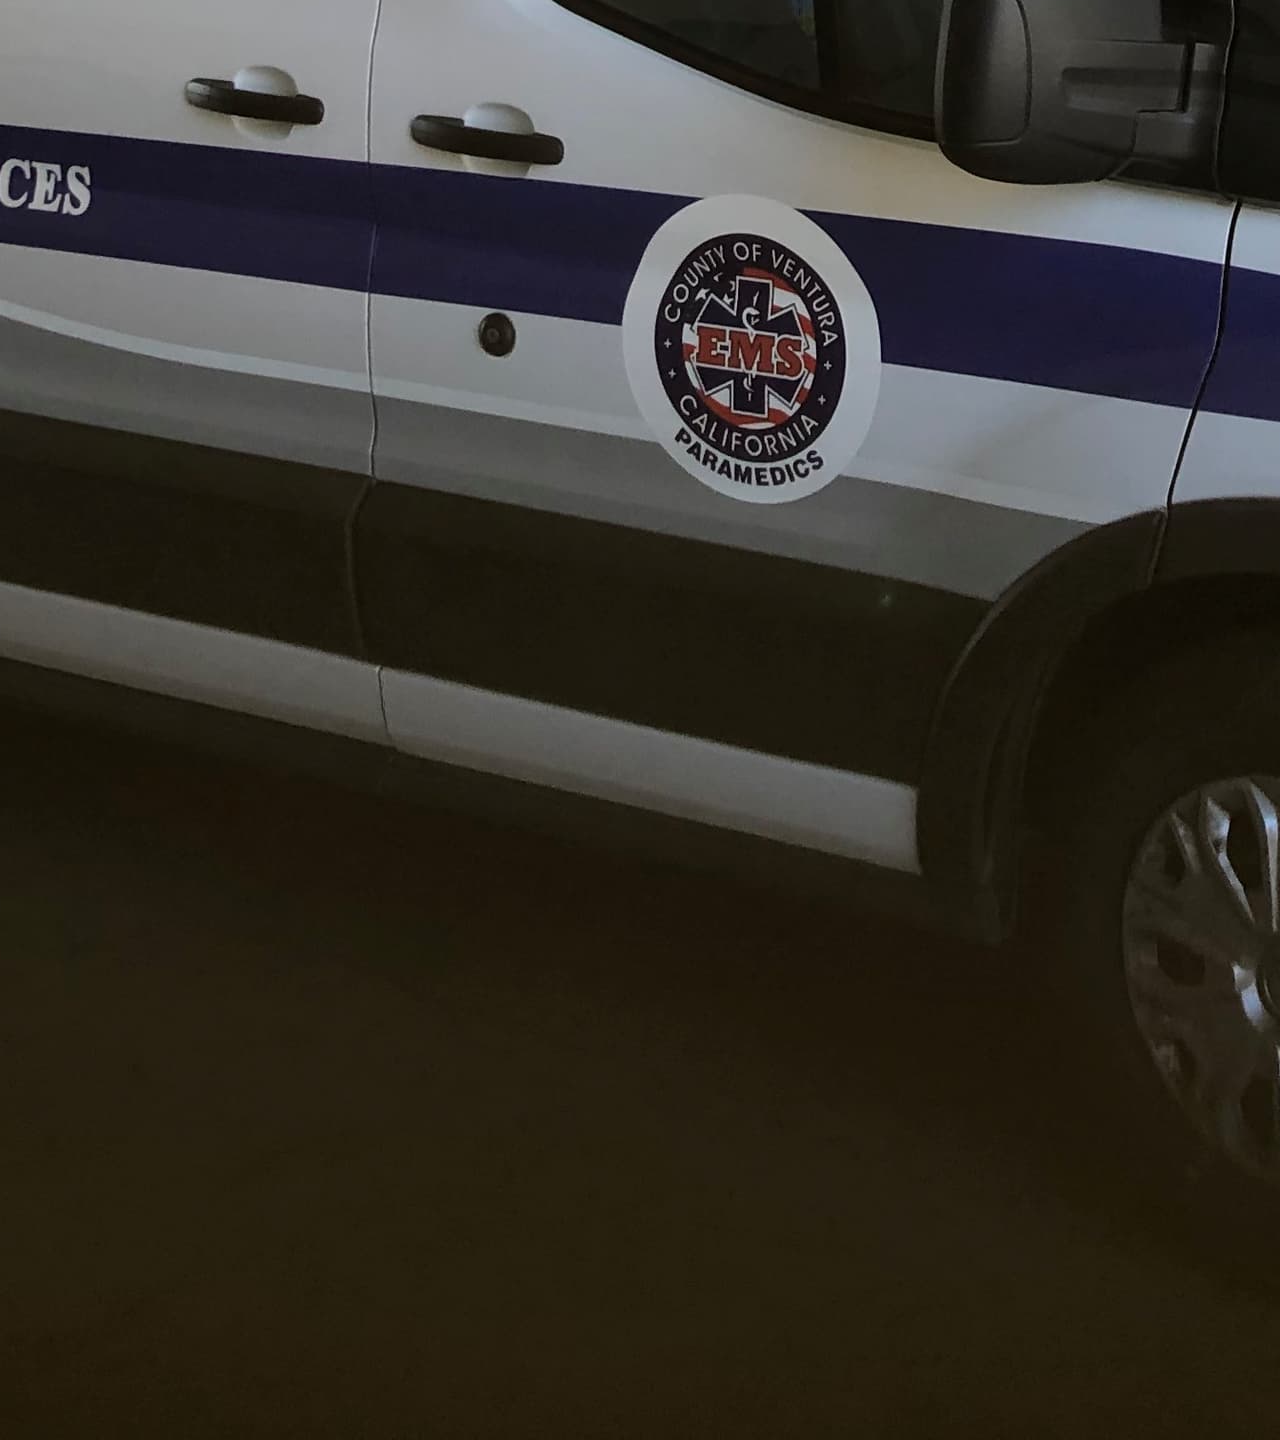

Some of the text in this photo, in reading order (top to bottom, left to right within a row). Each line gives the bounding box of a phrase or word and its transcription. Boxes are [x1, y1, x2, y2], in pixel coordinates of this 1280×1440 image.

[664, 241, 839, 347] COUNTY OF VENTURA
[694, 323, 805, 380] EMS
[679, 394, 819, 457] CALIFORNIA
[674, 427, 824, 487] PARAMEDICS
